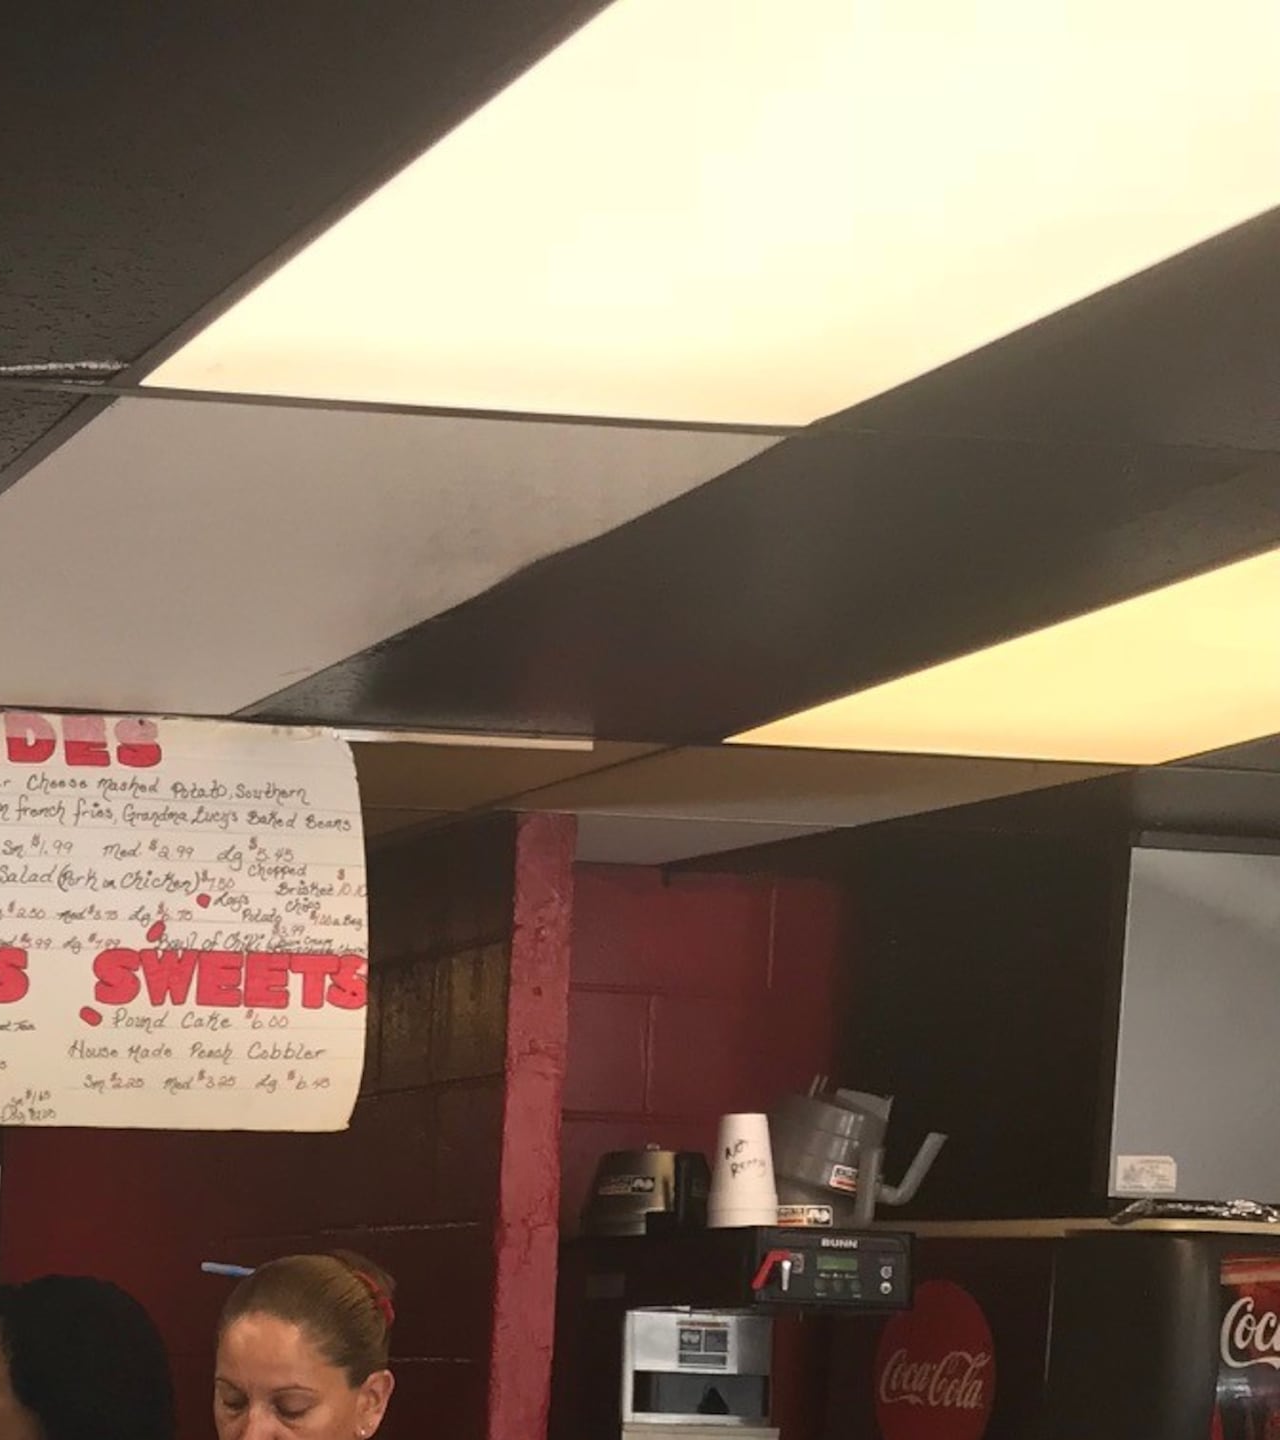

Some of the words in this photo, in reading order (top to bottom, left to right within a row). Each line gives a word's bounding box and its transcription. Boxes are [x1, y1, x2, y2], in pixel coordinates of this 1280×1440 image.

[25, 770, 88, 797] Cheese
[96, 775, 160, 801] Mashed
[235, 783, 310, 807] Southern
[122, 802, 191, 829] Grandma
[247, 810, 298, 829] Baked
[305, 813, 352, 832] Beans
[92, 947, 369, 1010] SWEETS
[111, 1007, 167, 1032] Pound
[180, 1010, 233, 1032] Cake
[67, 1040, 120, 1061] House
[189, 1041, 234, 1066] Peach
[246, 1041, 328, 1061] Cobbler
[880, 1347, 990, 1410] Coca-Cola
